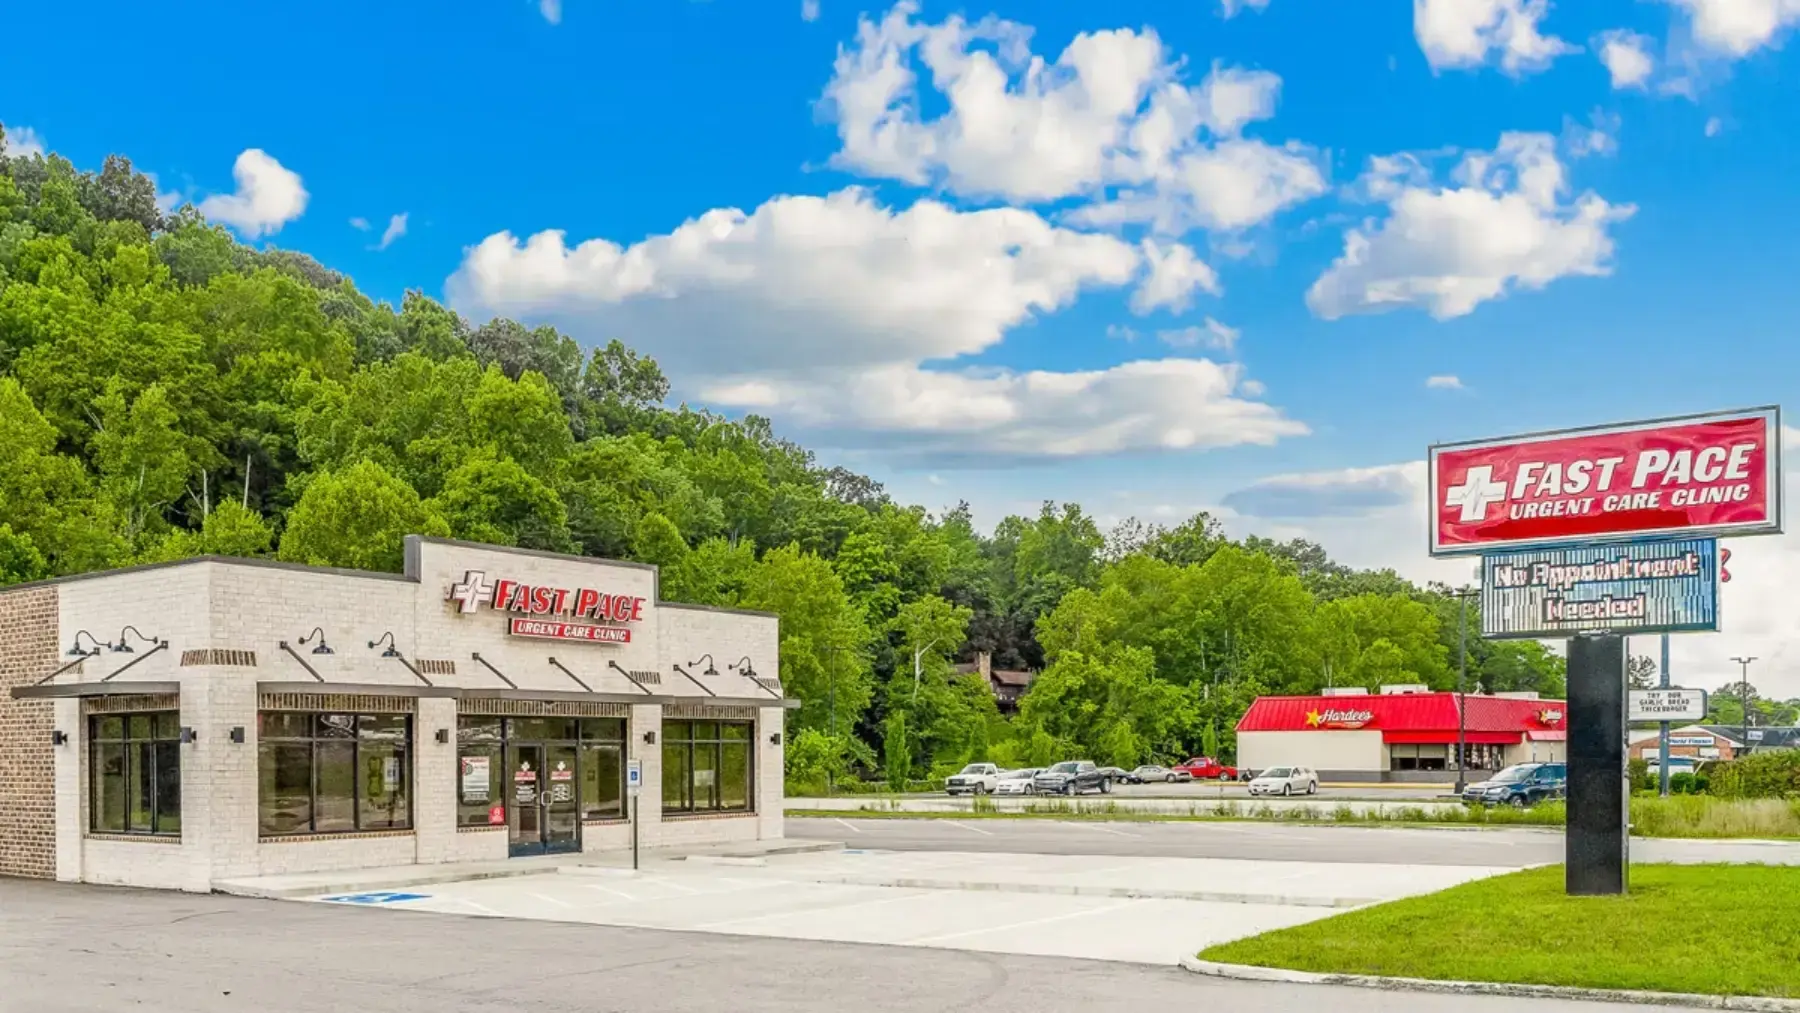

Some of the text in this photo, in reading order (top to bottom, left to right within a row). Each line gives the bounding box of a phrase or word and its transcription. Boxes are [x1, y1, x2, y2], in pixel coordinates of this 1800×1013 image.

[1510, 443, 1756, 500] FAST PACE
[1510, 483, 1750, 521] URGENT CARE CLINIC
[1494, 553, 1699, 591] No Appointment
[495, 579, 647, 622] FAST PACE
[1546, 595, 1645, 621] Needed
[517, 621, 627, 642] URGENT CARE CLINIC
